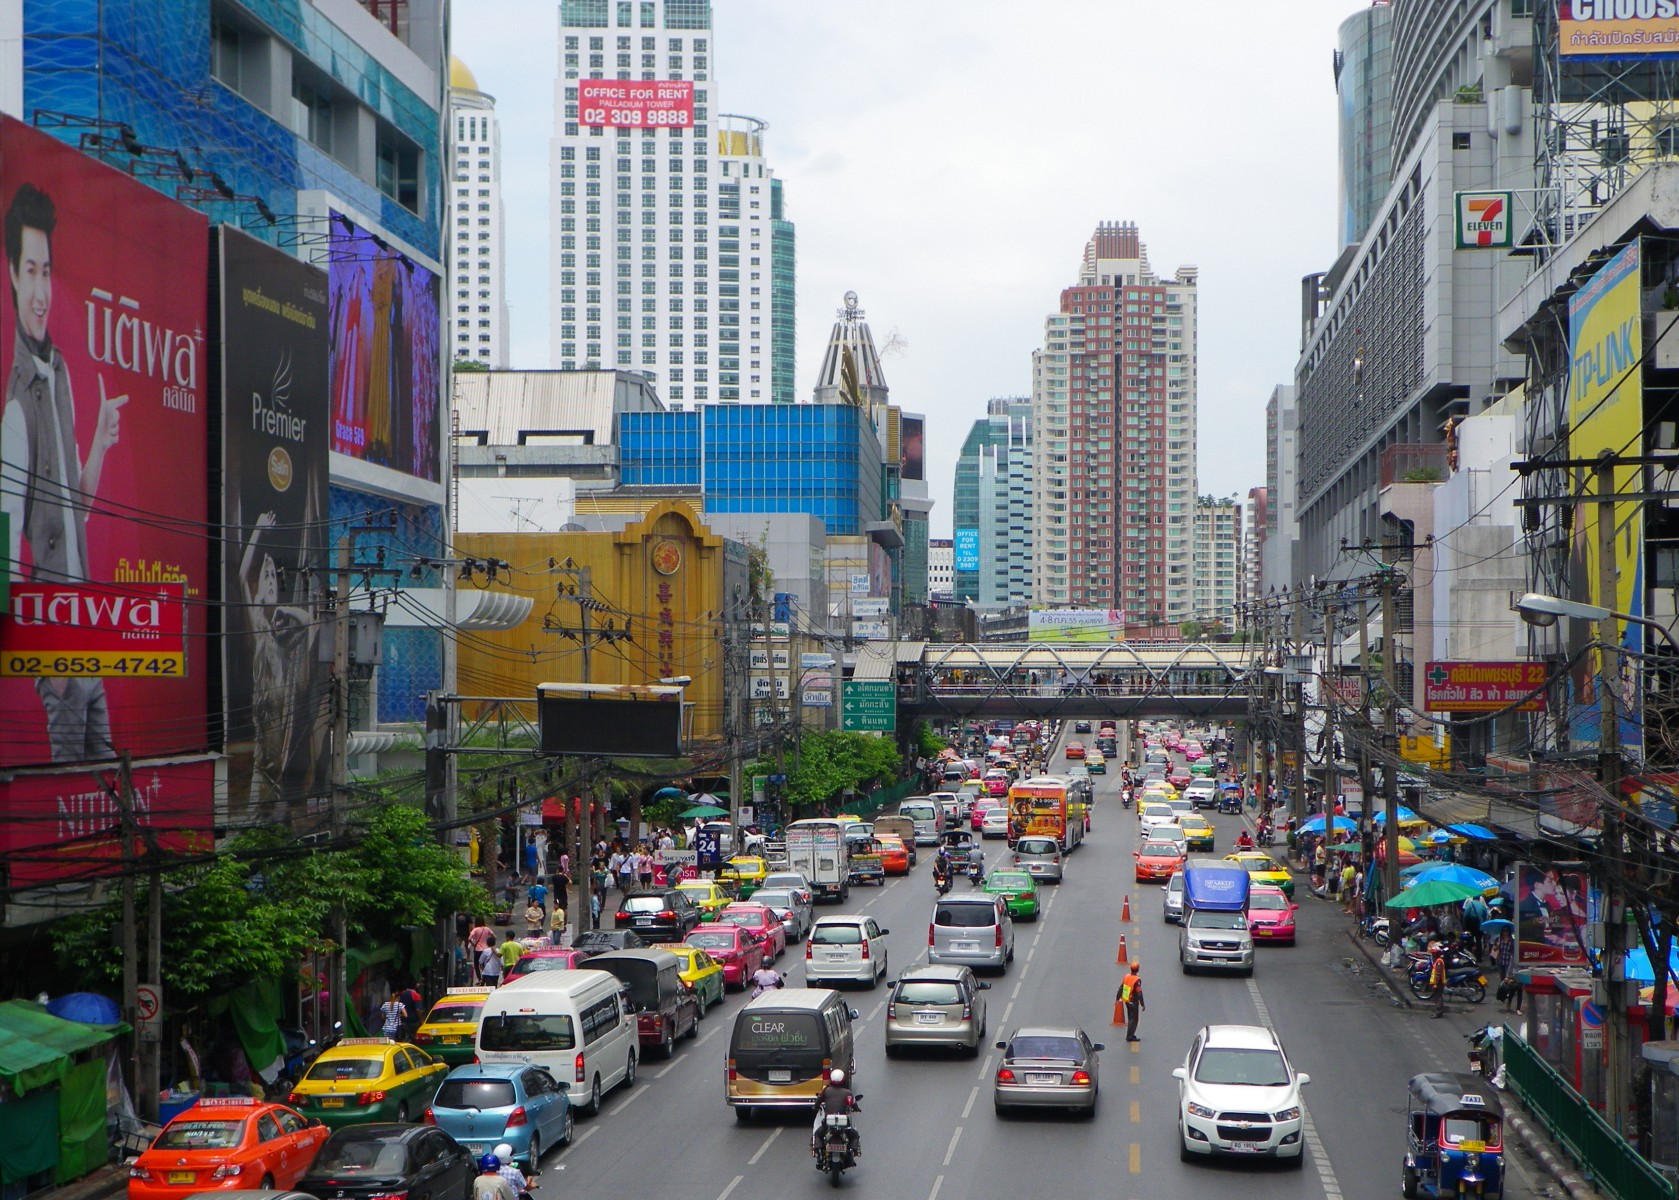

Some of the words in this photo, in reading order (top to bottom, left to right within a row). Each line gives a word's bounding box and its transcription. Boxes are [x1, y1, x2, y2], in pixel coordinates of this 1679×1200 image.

[1571, 0, 1679, 20] Choos
[584, 88, 626, 98] OFFICE
[630, 89, 654, 99] FOR
[658, 89, 689, 99] RENT
[599, 100, 643, 108] PALLADIUM
[584, 108, 605, 123] 02
[611, 110, 642, 124] 309
[647, 110, 688, 125] 9888
[1575, 316, 1635, 401] TP-LINK
[253, 392, 307, 443] Premier
[9, 657, 177, 674] 02-653-4742
[1451, 664, 1523, 688] คลินิกเพชรบุรี
[1528, 666, 1544, 683] 22
[699, 840, 716, 852] 24
[751, 1022, 785, 1033] CLEAR
